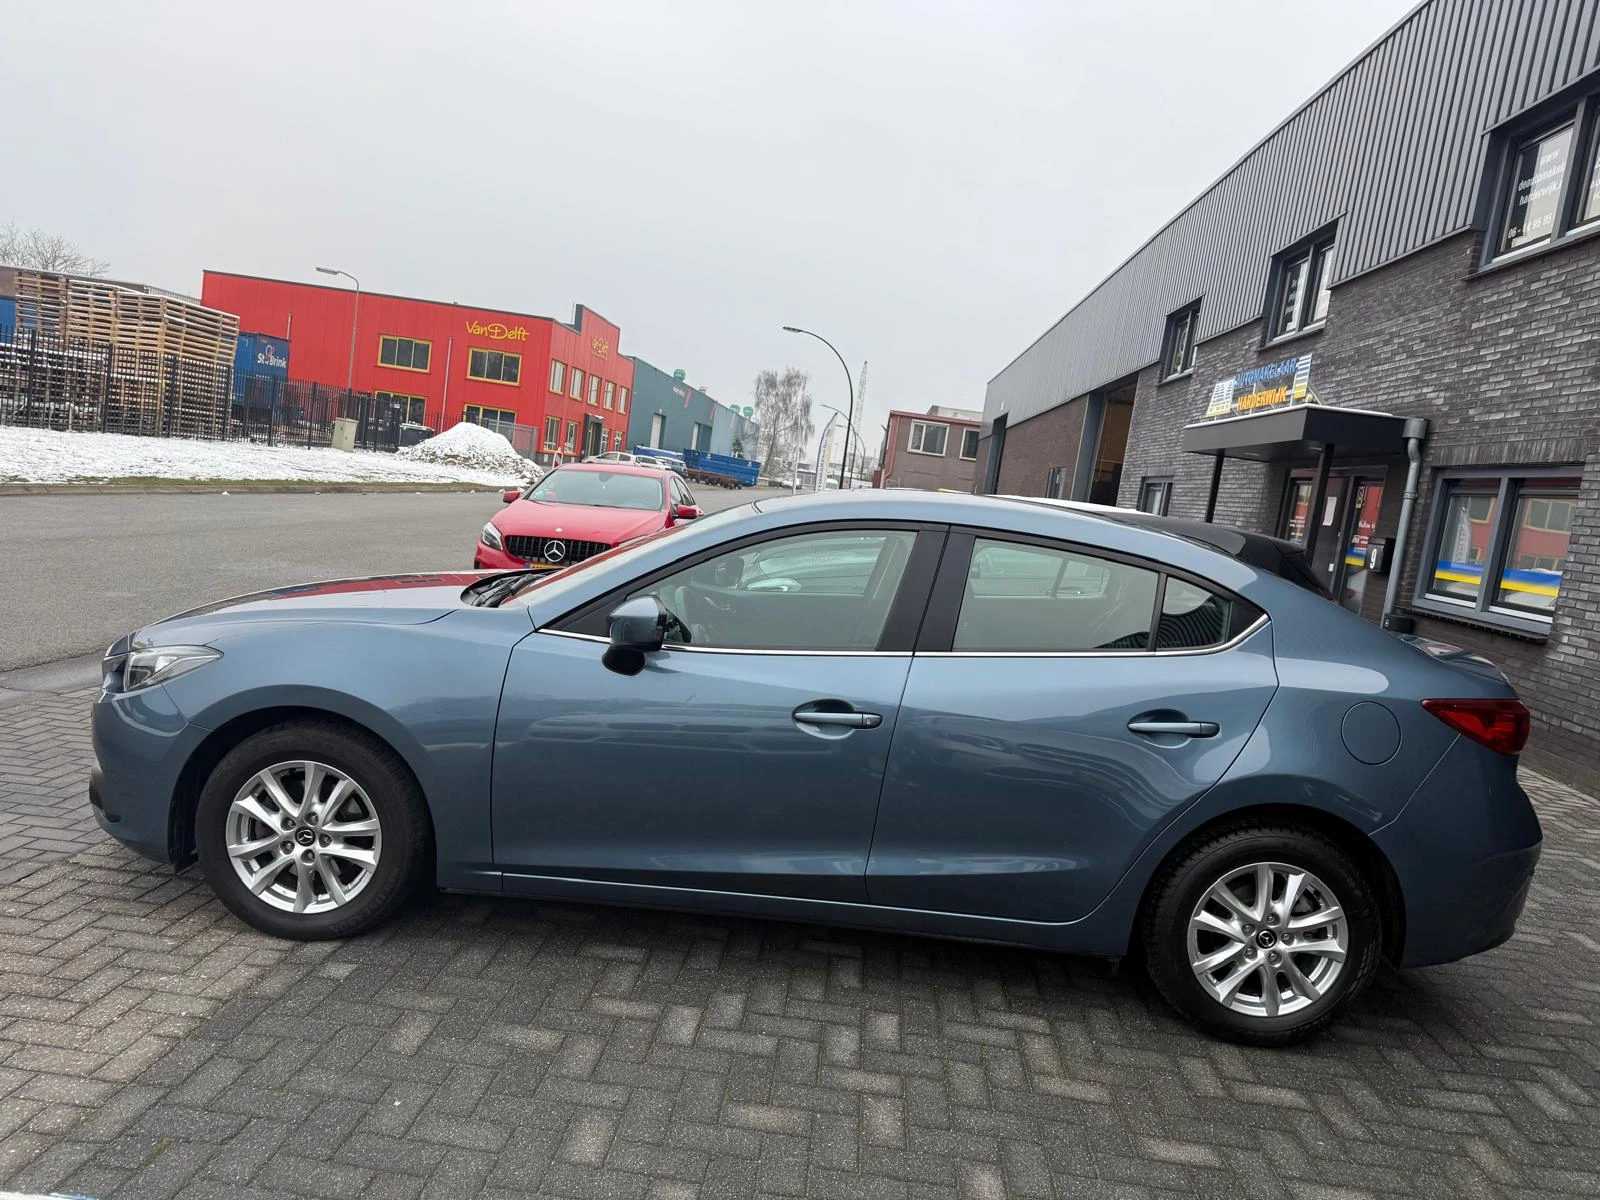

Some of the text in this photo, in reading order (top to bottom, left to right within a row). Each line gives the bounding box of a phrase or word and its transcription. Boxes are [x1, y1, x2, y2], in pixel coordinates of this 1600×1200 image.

[1234, 357, 1296, 387] AUTOMAKELAAR
[1237, 386, 1287, 411] HARDERWIJK
[1369, 548, 1377, 570] 9
